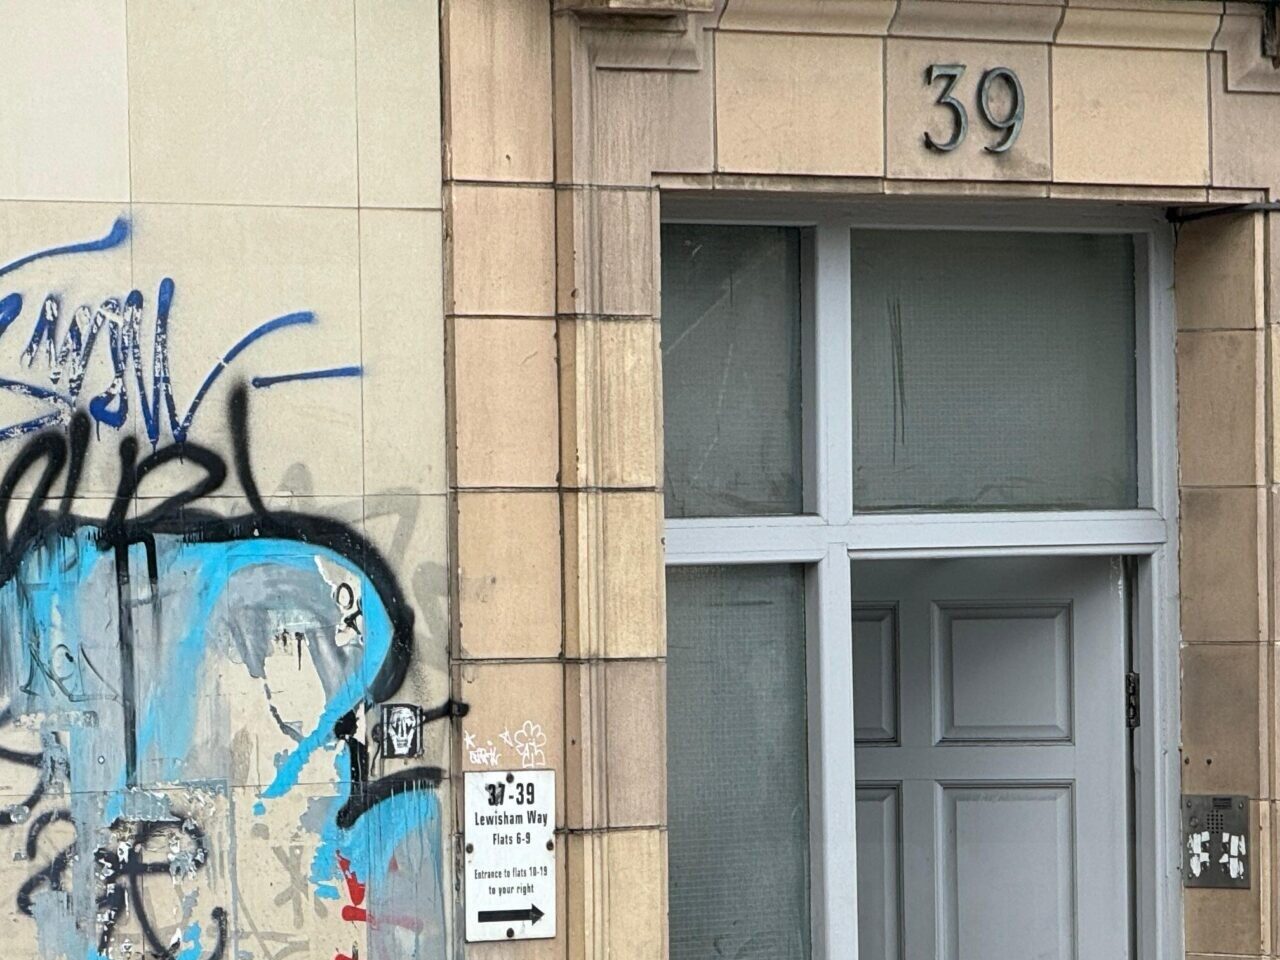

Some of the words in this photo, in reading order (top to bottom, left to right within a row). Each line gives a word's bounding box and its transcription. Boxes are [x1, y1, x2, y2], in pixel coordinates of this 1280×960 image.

[924, 64, 1025, 152] 39
[486, 782, 535, 807] 37-39
[475, 811, 523, 826] Lewisham
[527, 810, 548, 827] Way
[492, 833, 513, 845] Flats
[516, 832, 531, 844] 6-9
[474, 868, 502, 880] Entrance
[504, 868, 511, 878] to
[512, 867, 527, 878] flats
[488, 886, 496, 895] to
[498, 885, 514, 896] your
[516, 883, 534, 896] right
